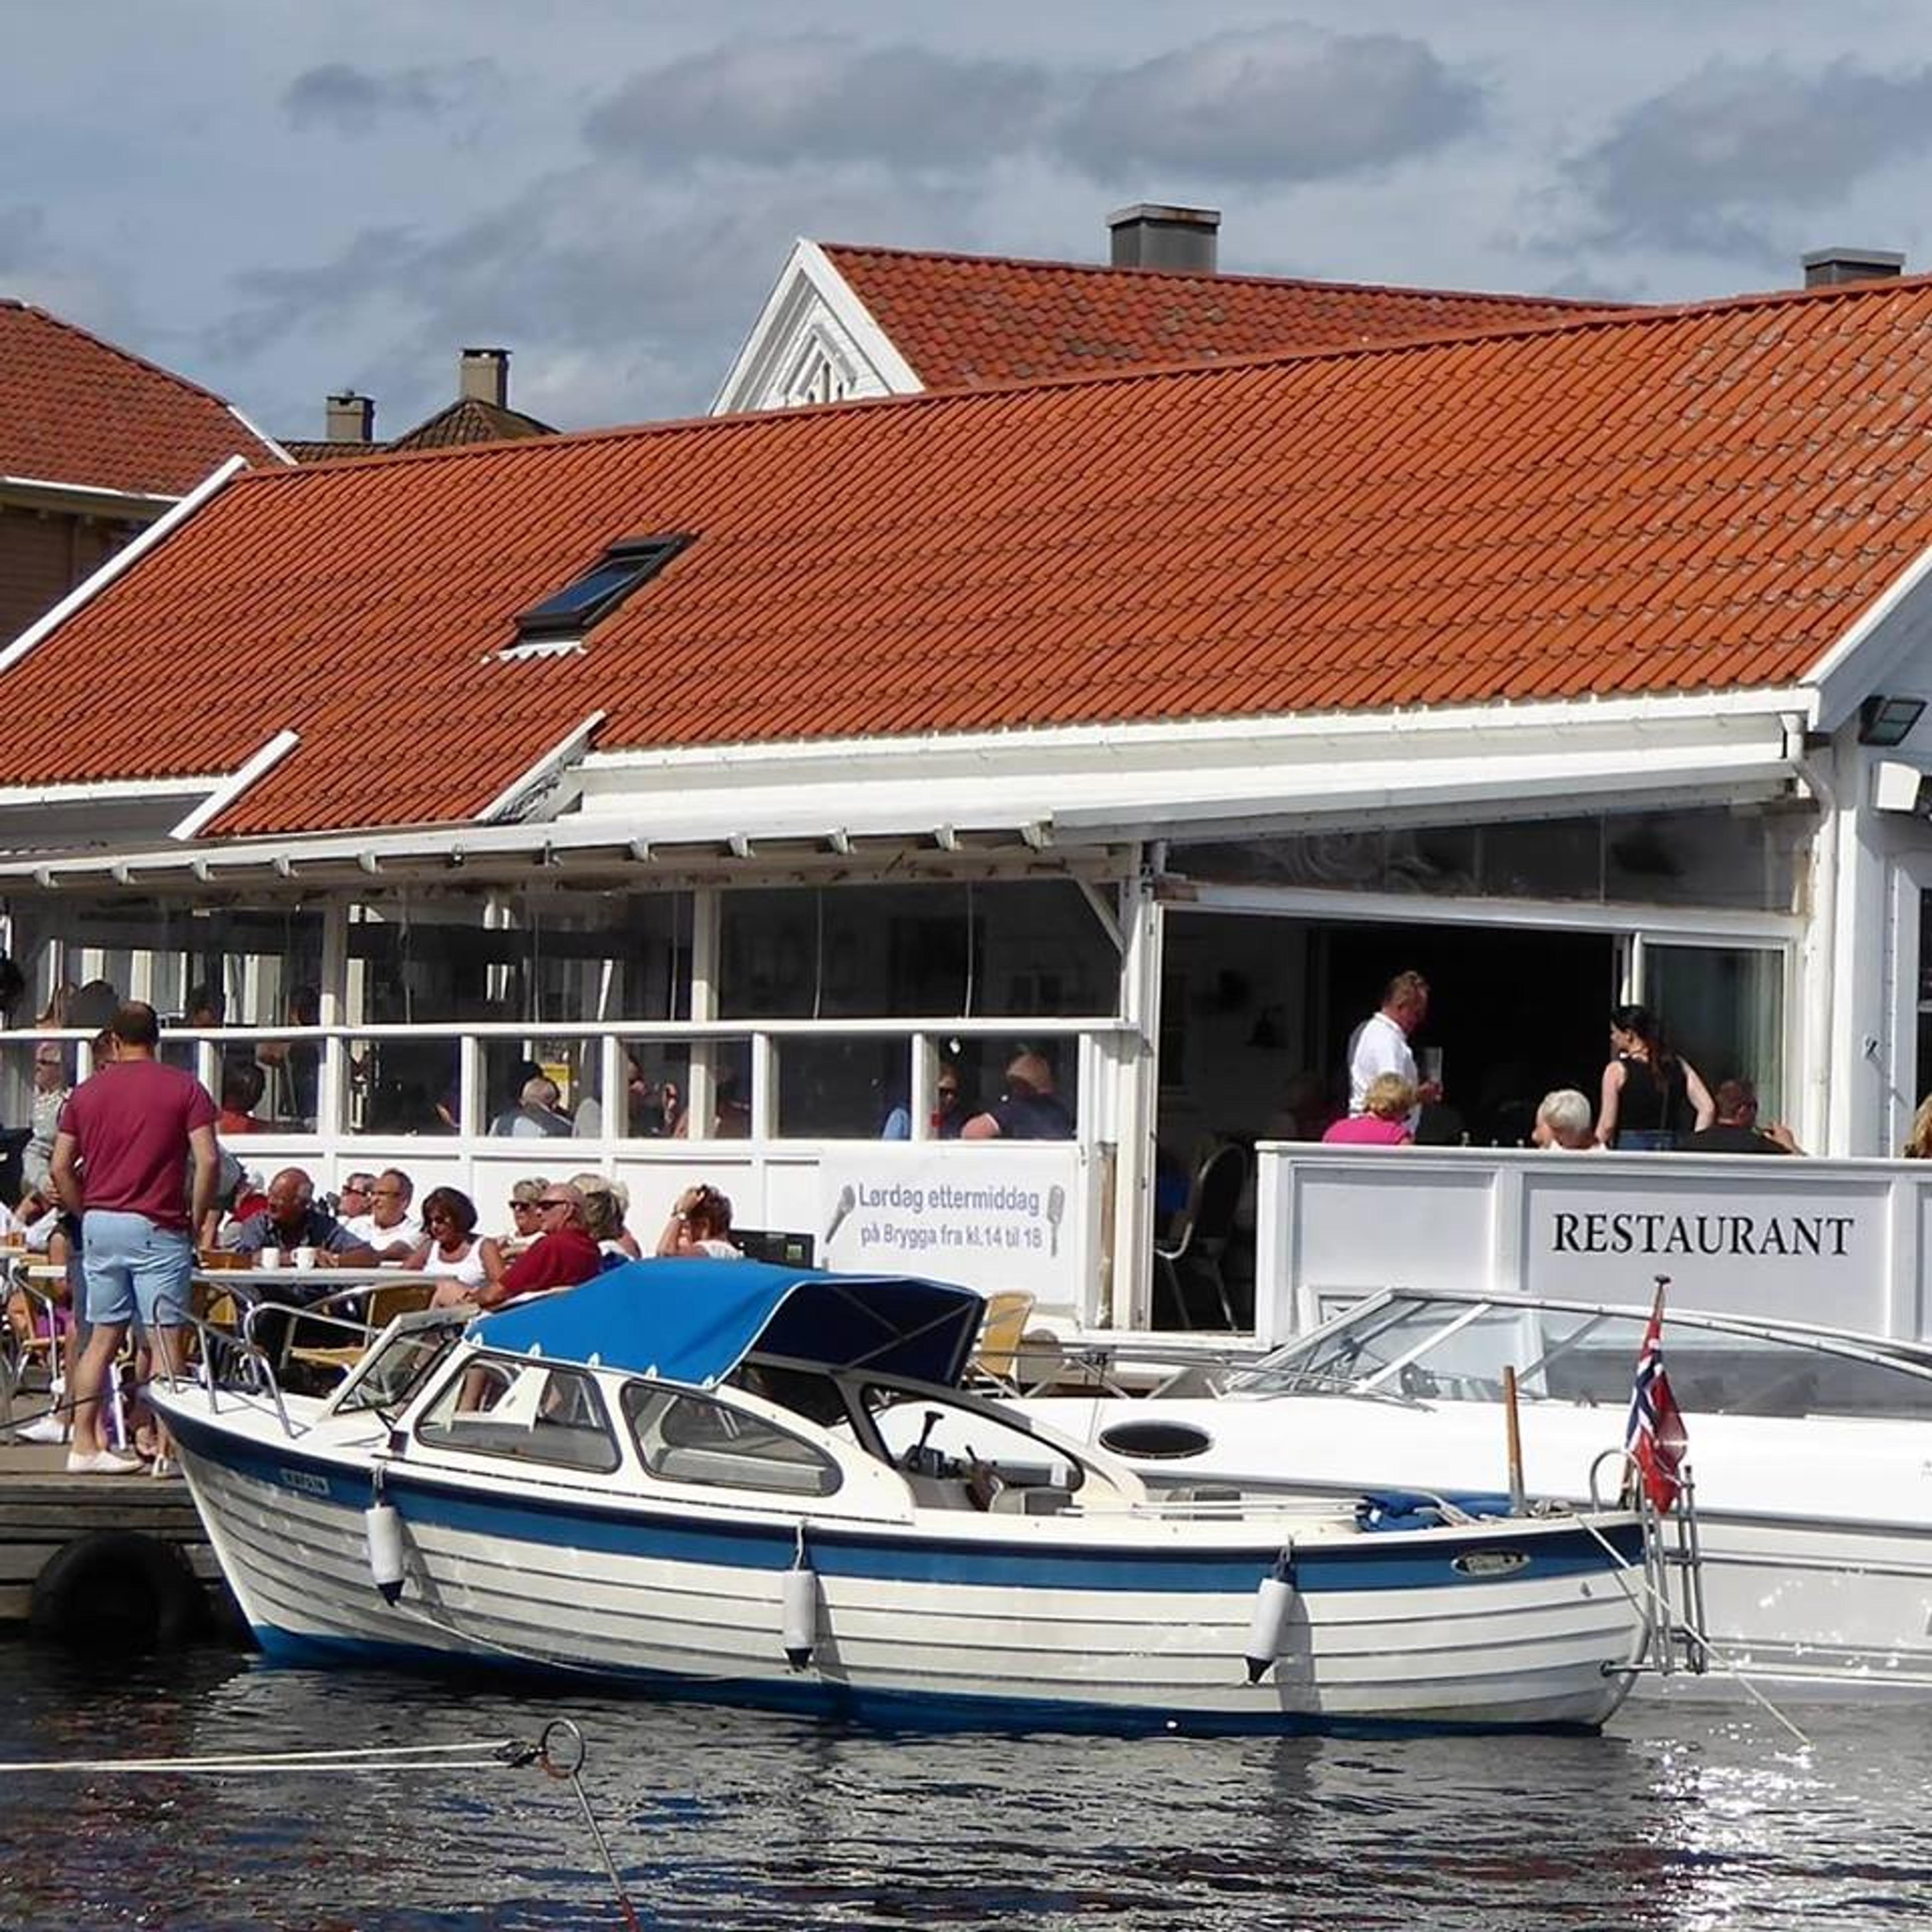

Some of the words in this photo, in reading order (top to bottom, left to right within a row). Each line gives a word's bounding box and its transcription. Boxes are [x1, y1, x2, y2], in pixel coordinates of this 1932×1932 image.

[859, 1183, 924, 1214] Lørdag
[928, 1186, 1040, 1217] ettermiddag
[861, 1224, 880, 1247] på
[884, 1224, 937, 1249] Brygga
[941, 1225, 963, 1244] fra
[1006, 1227, 1019, 1247] til
[1024, 1228, 1042, 1248] 18
[1552, 1213, 1855, 1256] RESTAURANT
